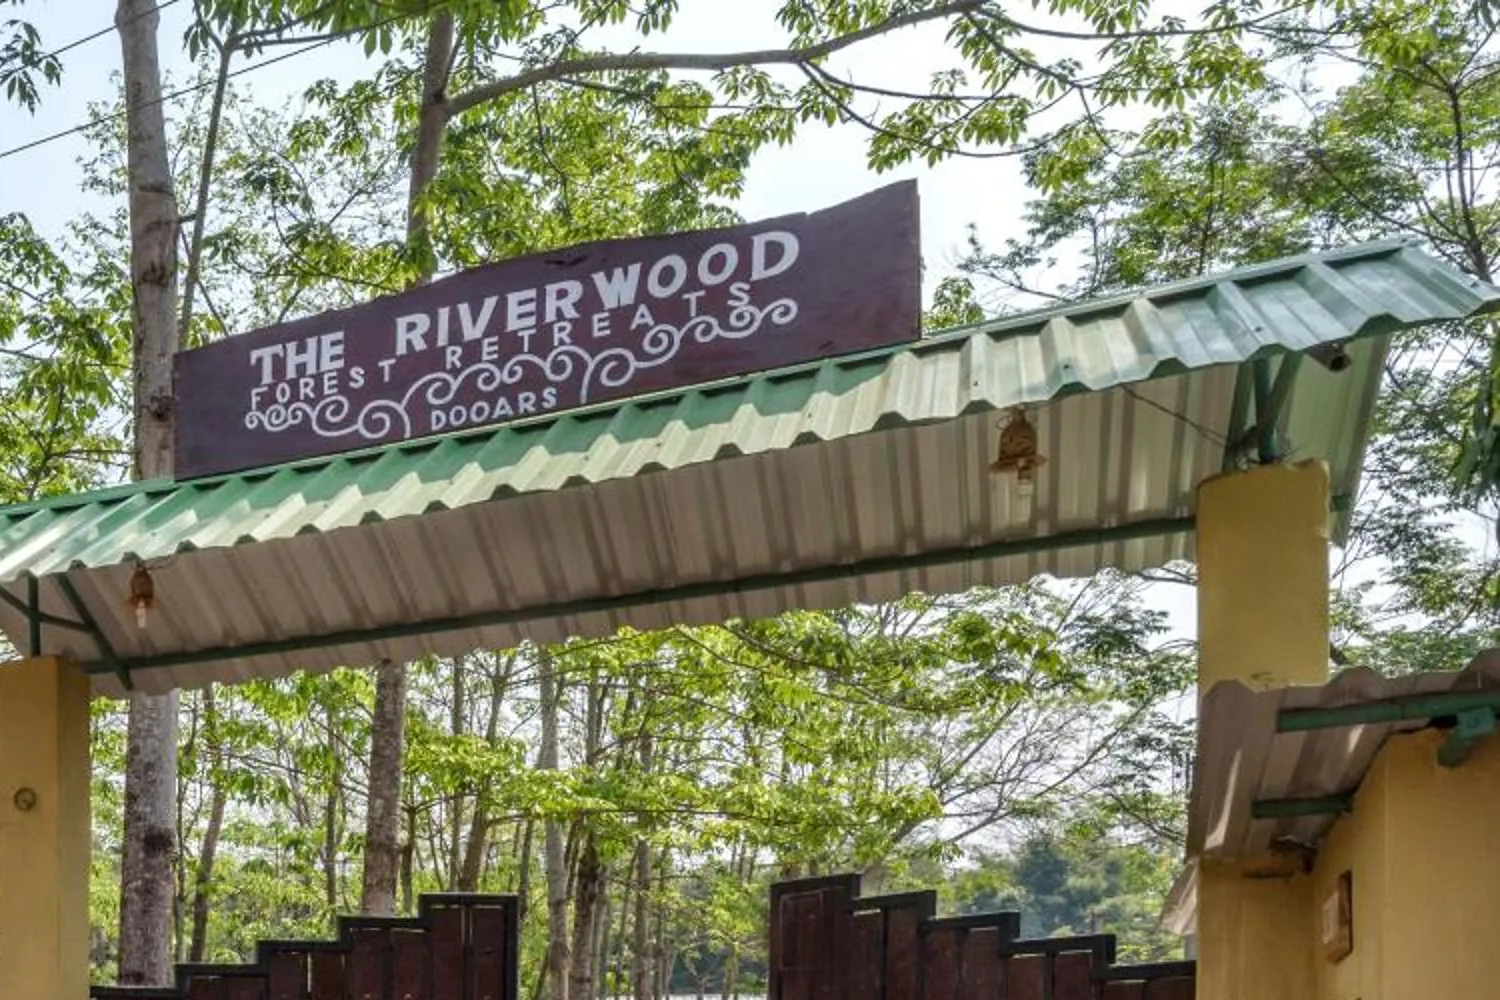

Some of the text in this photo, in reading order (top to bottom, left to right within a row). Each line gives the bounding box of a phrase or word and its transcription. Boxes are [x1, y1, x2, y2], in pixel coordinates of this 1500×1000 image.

[250, 230, 799, 386] THE RIVERWOOD
[251, 282, 750, 411] FOREST RETREATS
[430, 387, 557, 430] DOOARS
